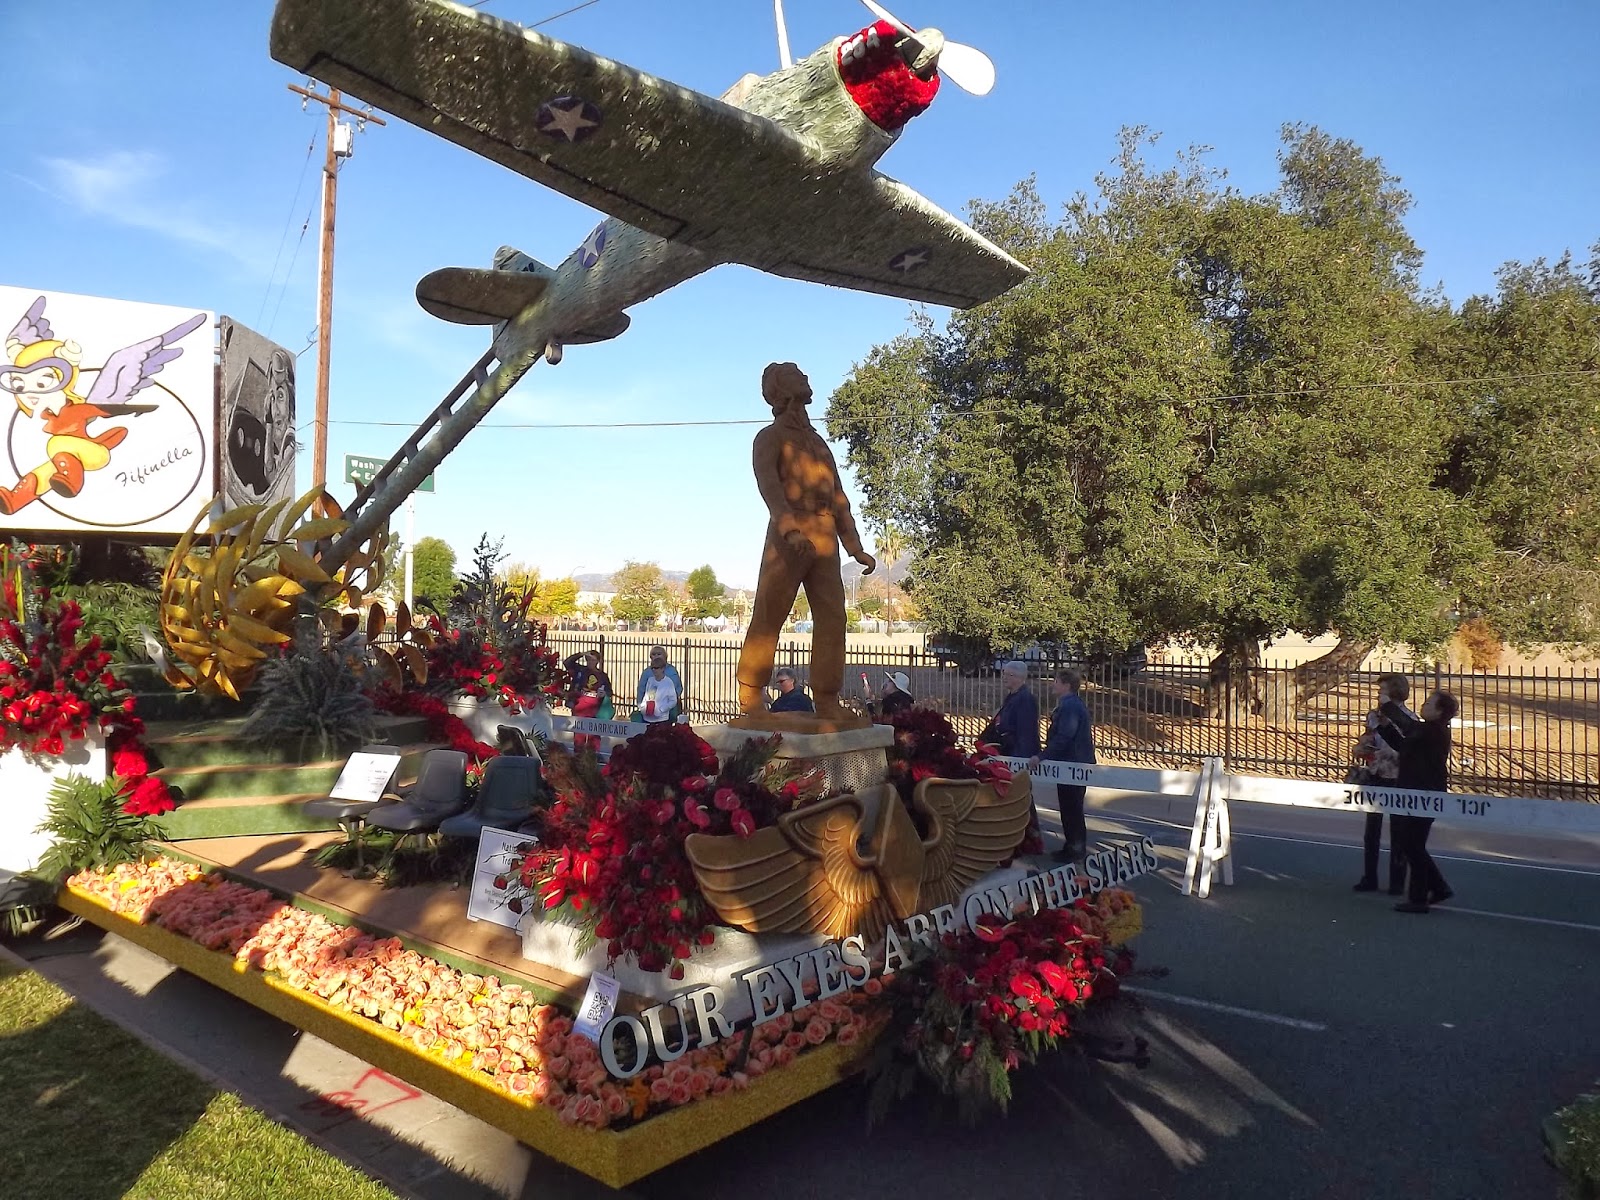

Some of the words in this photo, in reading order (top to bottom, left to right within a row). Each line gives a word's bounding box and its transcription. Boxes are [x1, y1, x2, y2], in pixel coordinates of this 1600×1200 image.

[115, 447, 193, 487] Fifinella
[588, 722, 628, 735] BARRICADE
[1068, 766, 1093, 781] JCL
[1343, 790, 1443, 812] BARRICADE
[1456, 798, 1491, 816] JCL
[599, 985, 735, 1079] OUR
[742, 934, 871, 1027] EYES
[882, 903, 959, 975] ARE
[964, 884, 1014, 937] ON
[1018, 863, 1083, 916] THE
[1085, 836, 1159, 893] STARS
